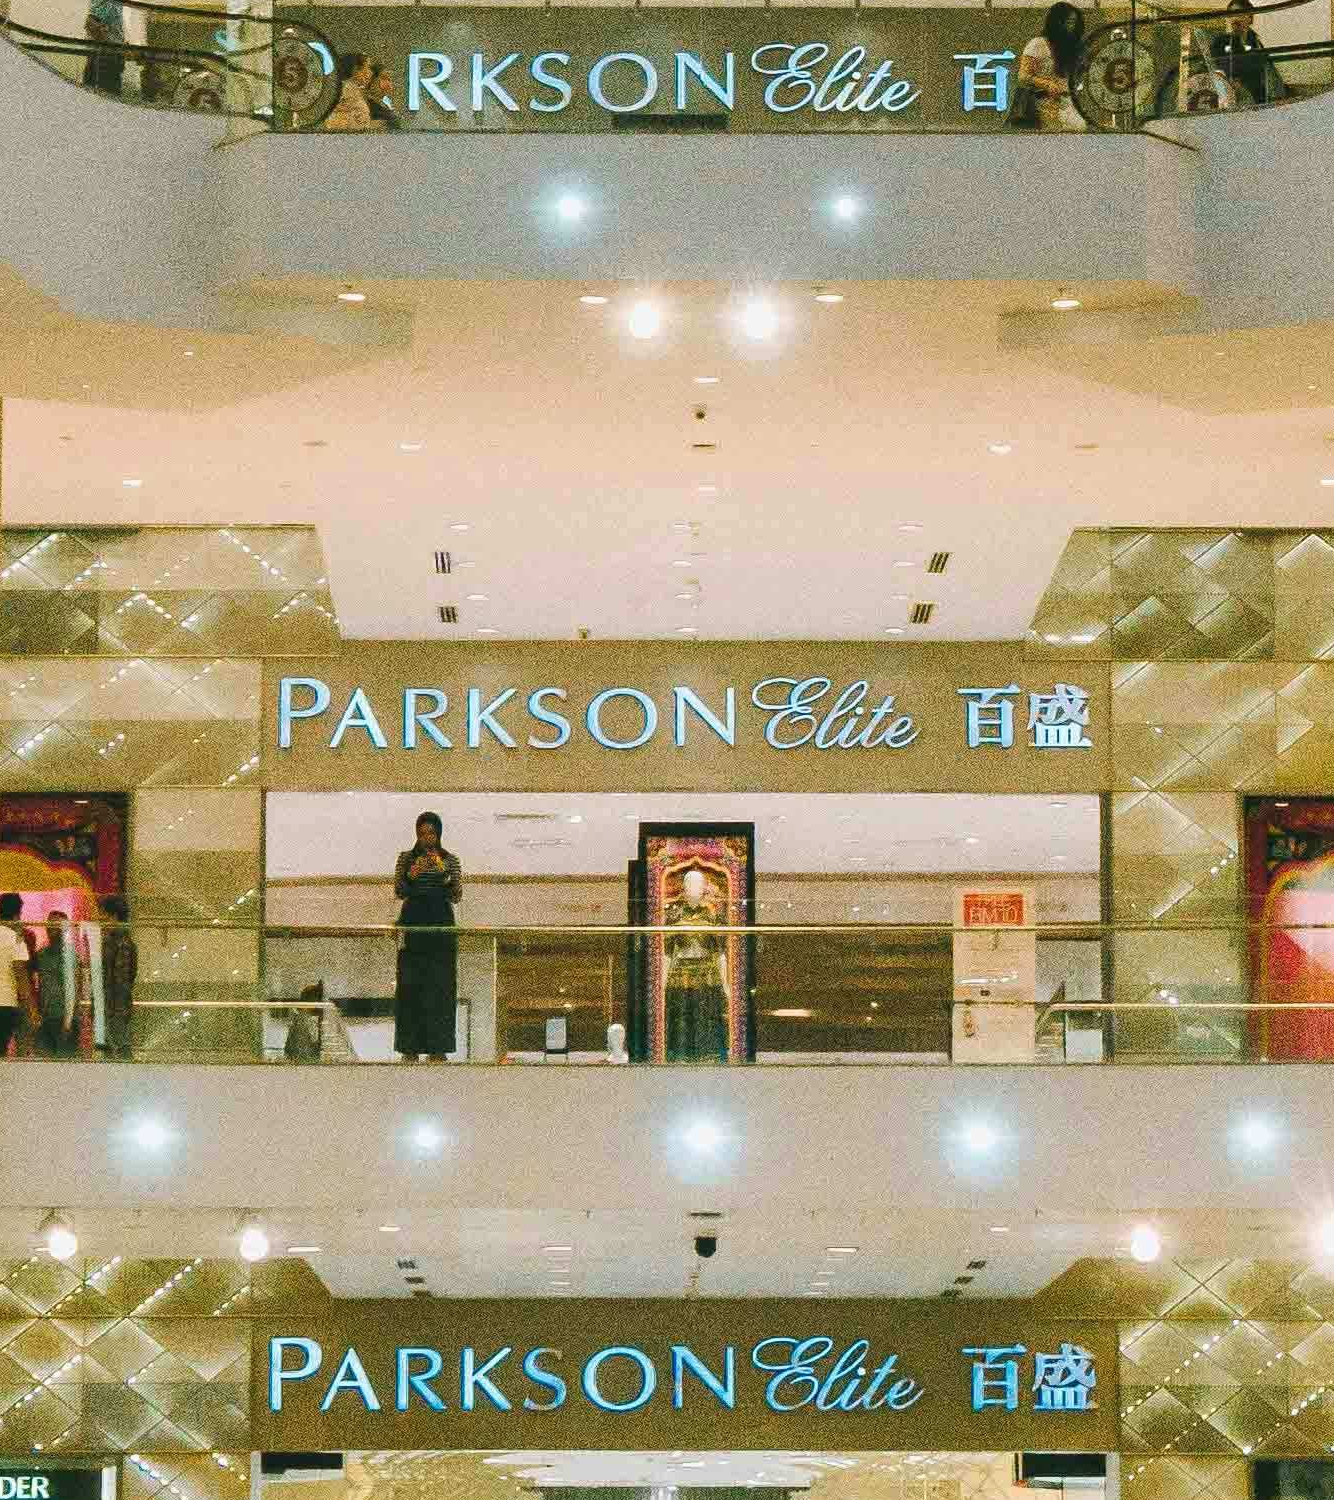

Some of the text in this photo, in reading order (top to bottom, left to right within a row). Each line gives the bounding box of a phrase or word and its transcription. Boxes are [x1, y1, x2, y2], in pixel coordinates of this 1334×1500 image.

[750, 42, 922, 114] Elite
[277, 676, 1093, 752] PARKSON Elite 百盛
[269, 1337, 1098, 1413] PARKSON Elite 百盛
